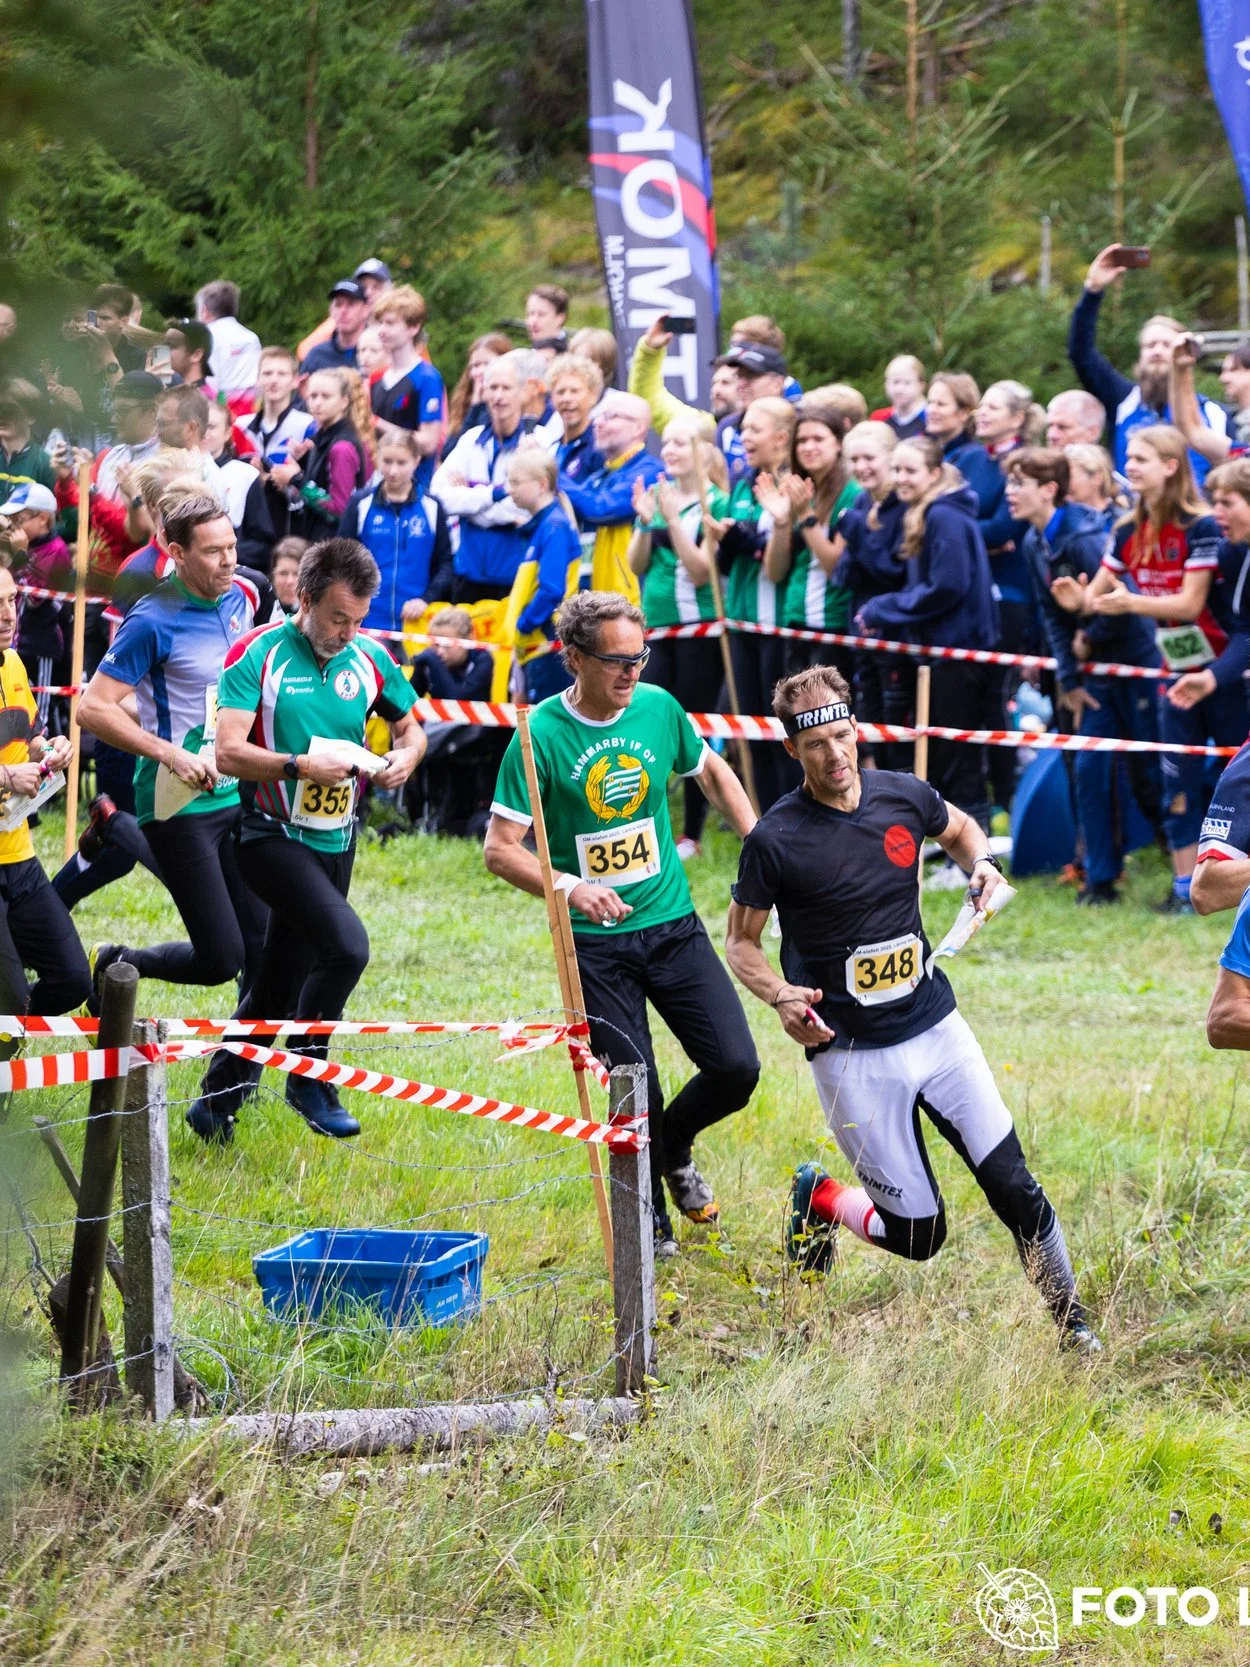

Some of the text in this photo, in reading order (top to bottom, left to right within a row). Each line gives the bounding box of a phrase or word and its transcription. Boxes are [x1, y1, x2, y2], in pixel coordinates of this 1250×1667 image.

[570, 737, 657, 781] HAMMARBY IF OF
[303, 783, 350, 815] 355
[588, 832, 650, 874] 354
[857, 947, 914, 990] 348
[858, 1170, 903, 1199] TRIMTEX
